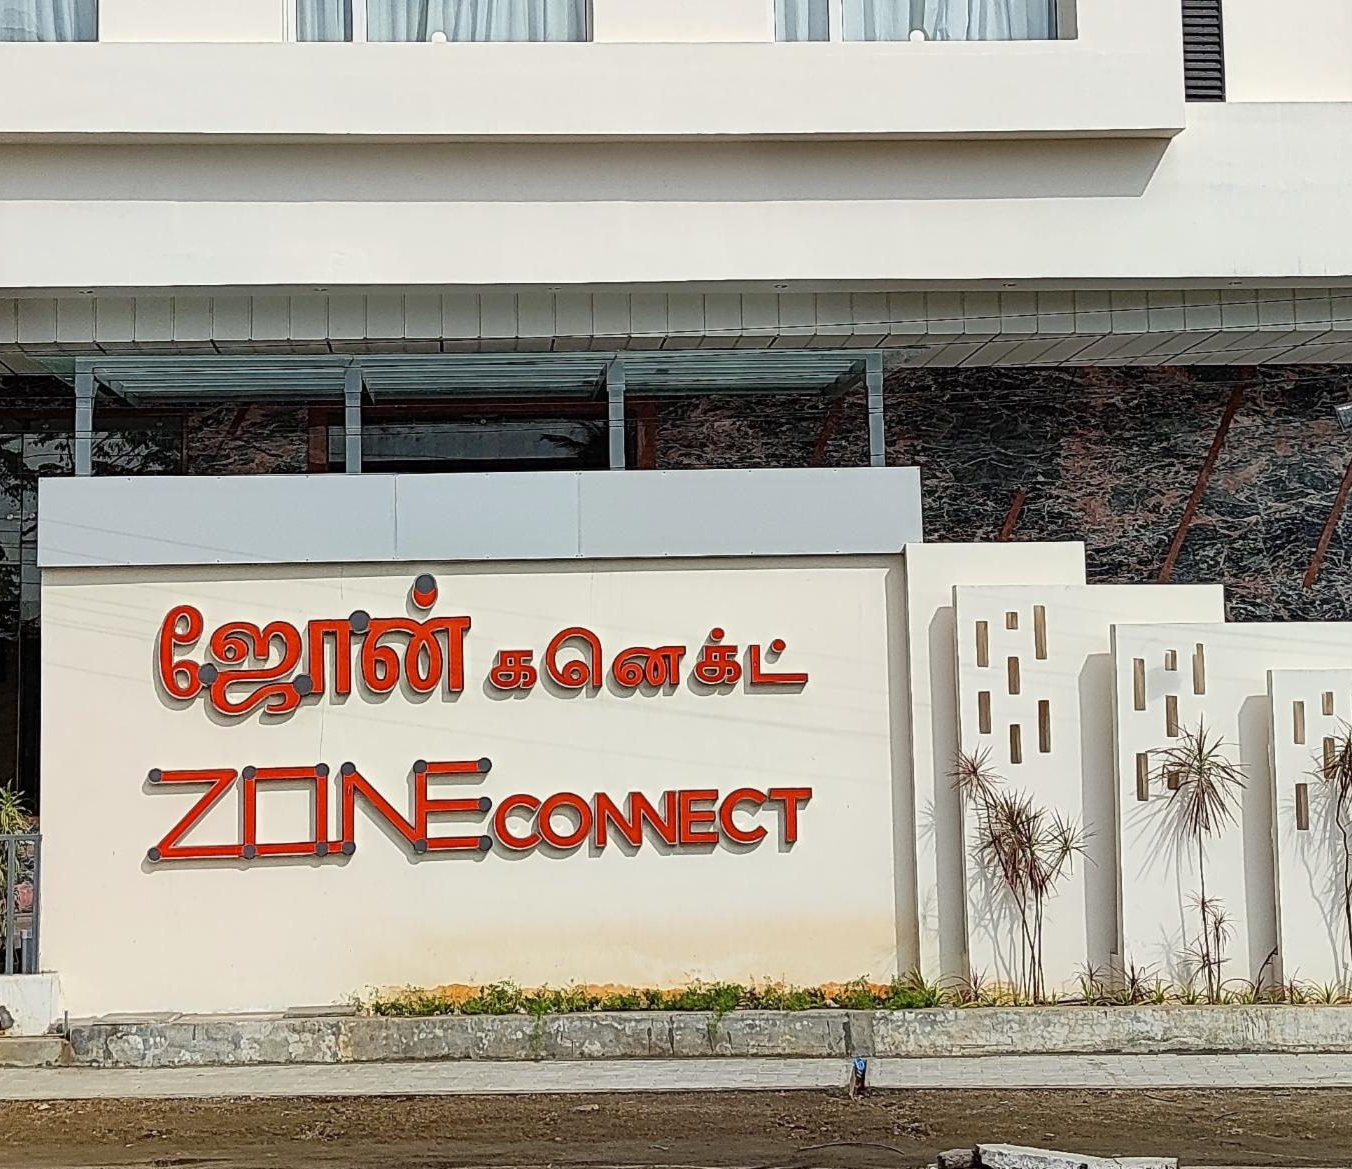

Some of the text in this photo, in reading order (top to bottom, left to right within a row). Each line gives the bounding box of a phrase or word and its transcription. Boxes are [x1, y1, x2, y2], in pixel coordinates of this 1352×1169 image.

[160, 573, 809, 716] ஜோன் கனெக்ட்
[148, 758, 813, 860] ZONE CONNECT
